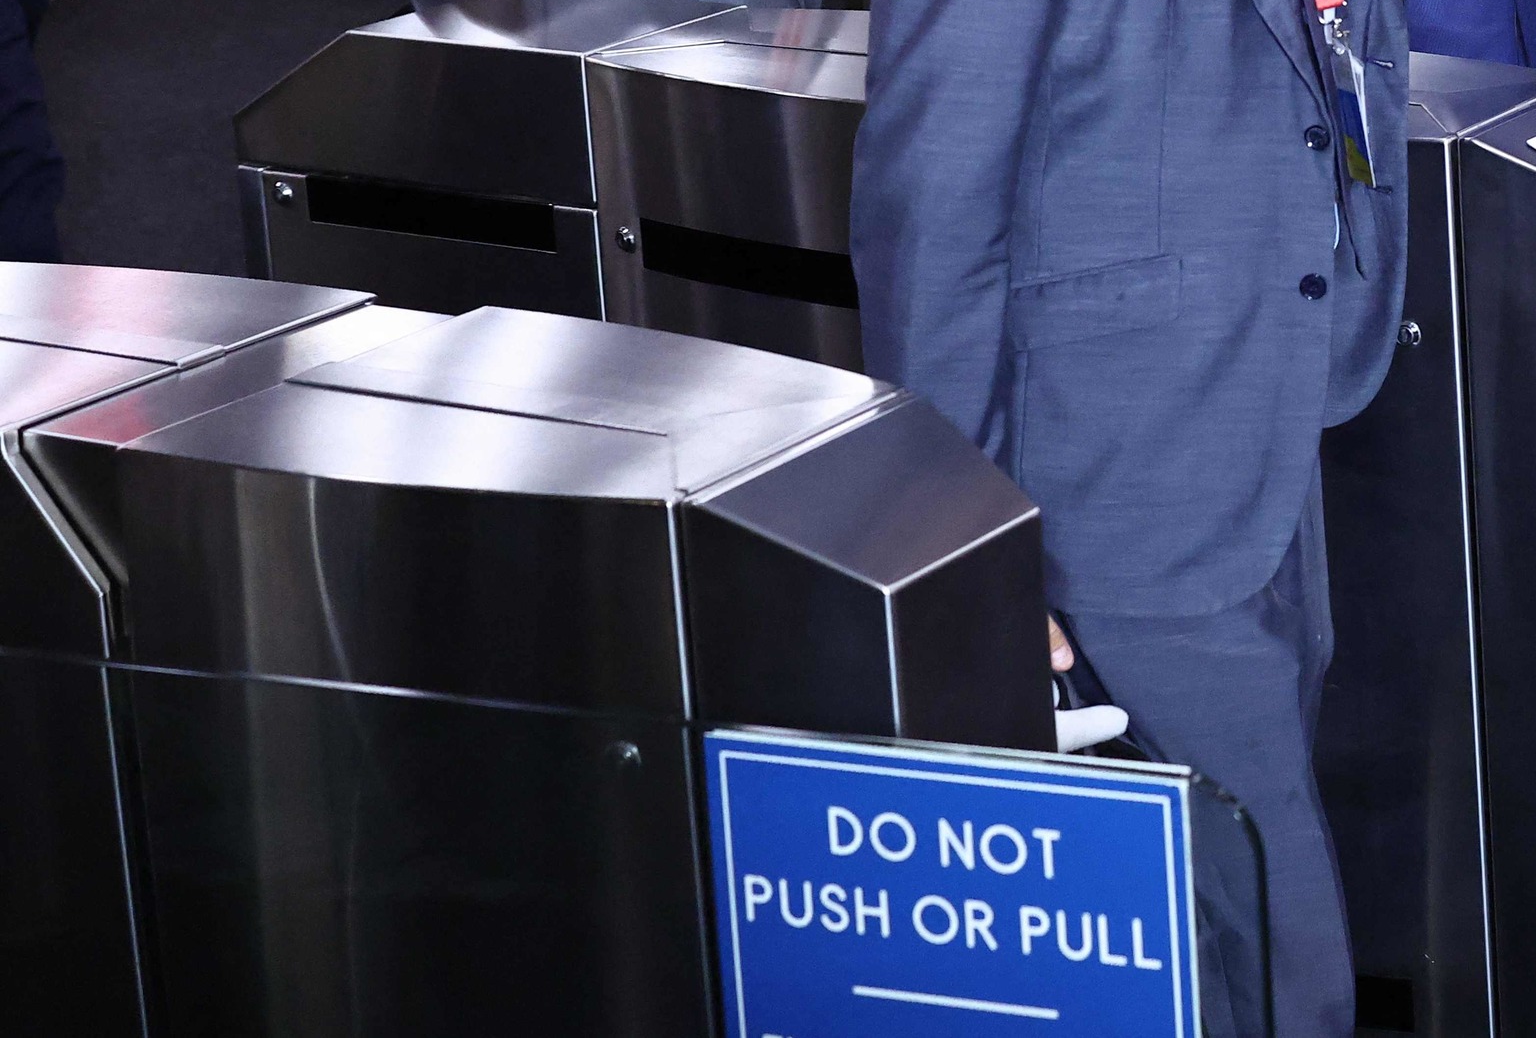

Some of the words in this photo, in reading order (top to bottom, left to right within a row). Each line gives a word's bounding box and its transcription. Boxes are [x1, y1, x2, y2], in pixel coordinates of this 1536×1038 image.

[826, 805, 916, 863] DO
[938, 818, 1061, 880] NOT
[743, 874, 890, 938] PUSH
[912, 894, 998, 951] OR
[1019, 905, 1163, 971] PULL
